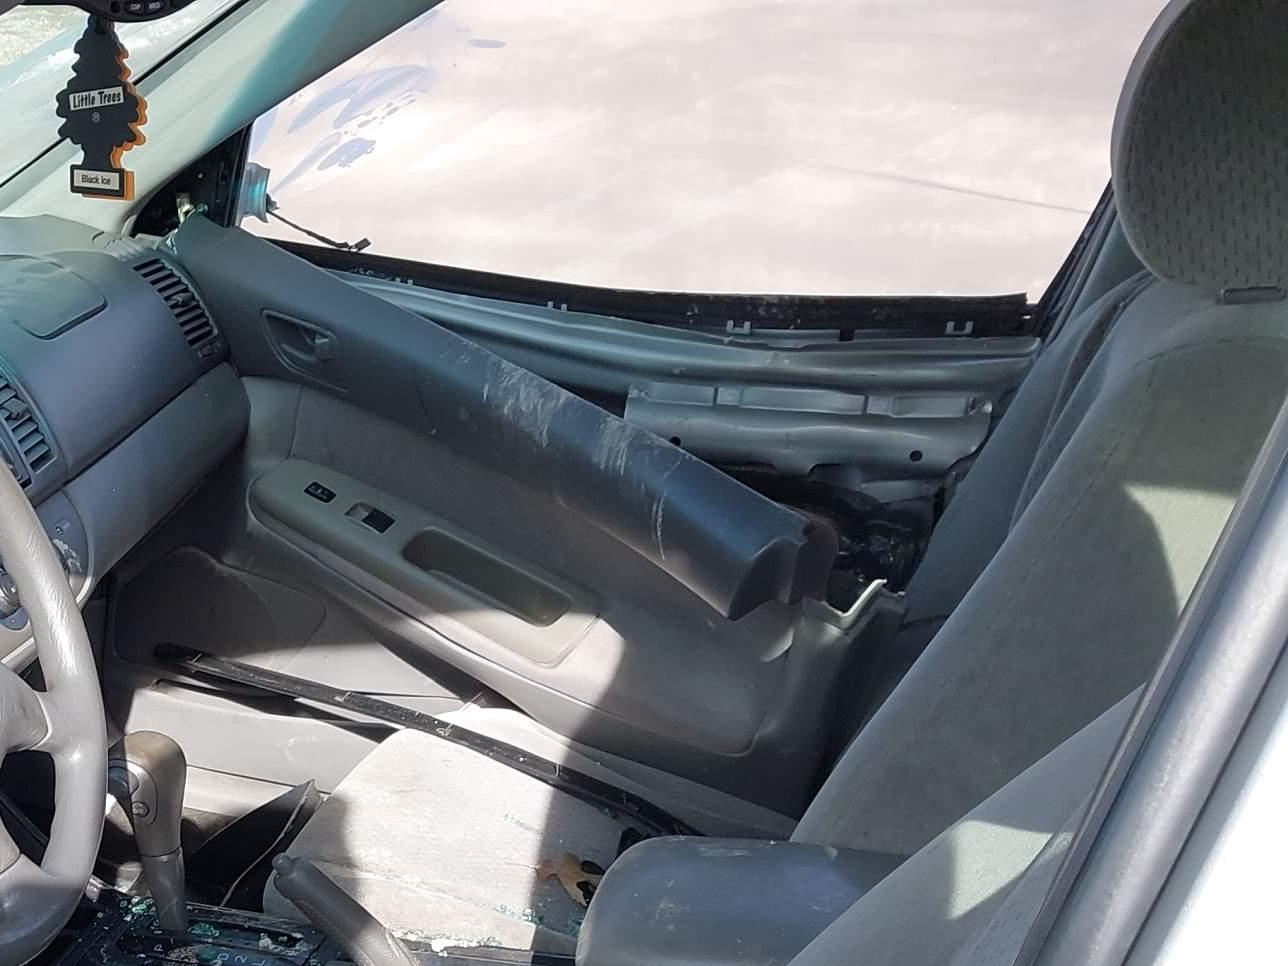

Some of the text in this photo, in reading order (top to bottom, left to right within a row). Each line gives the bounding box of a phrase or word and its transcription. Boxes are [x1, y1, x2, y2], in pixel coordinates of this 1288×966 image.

[71, 90, 122, 109] Little Trees
[82, 174, 111, 186] Black Ice
[233, 954, 249, 964] 2
[252, 958, 267, 966] L
